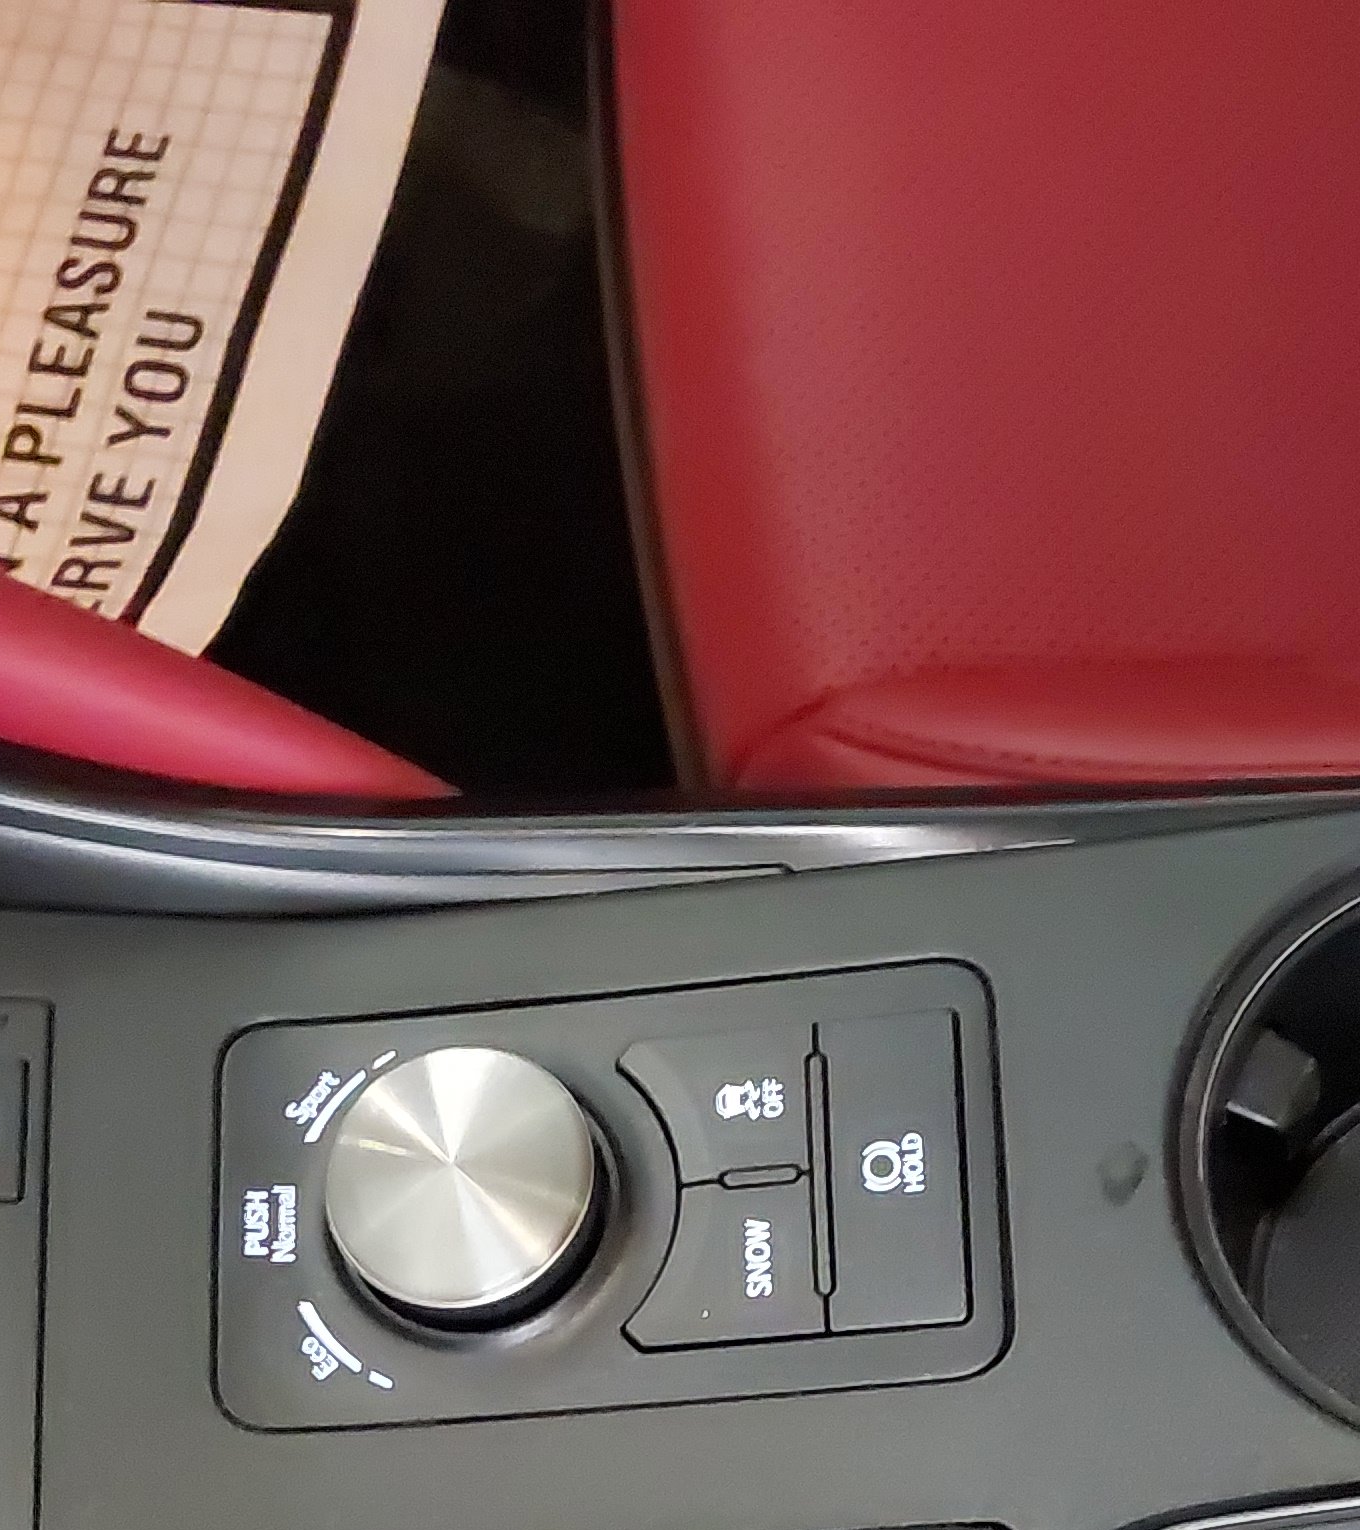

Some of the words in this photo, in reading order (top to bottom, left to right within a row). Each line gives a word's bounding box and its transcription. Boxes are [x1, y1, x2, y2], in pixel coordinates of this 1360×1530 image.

[3, 127, 172, 467] PLEASURE
[107, 309, 206, 448] YOU
[285, 1071, 341, 1125] Sport
[761, 1078, 784, 1119] OFF
[903, 1133, 925, 1193] HOLD
[243, 1190, 270, 1256] PUSH
[269, 1184, 297, 1263] Normal
[744, 1218, 773, 1298] SNOW
[301, 1336, 340, 1381] Eco
